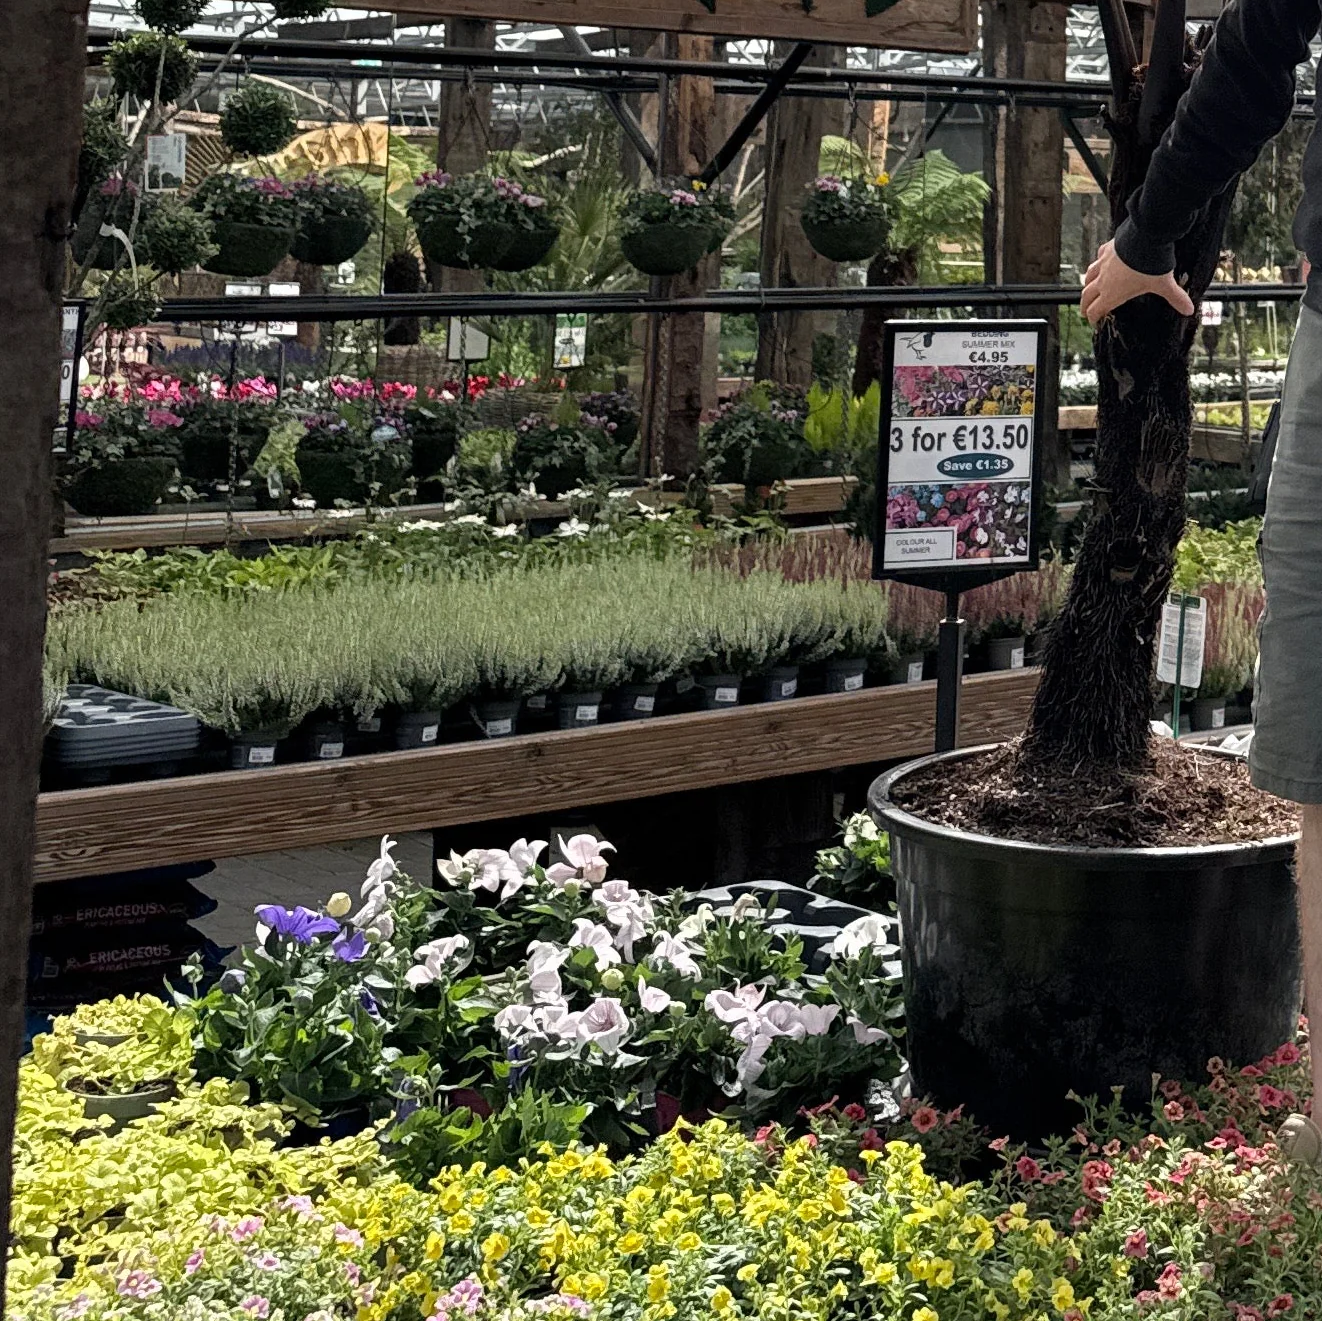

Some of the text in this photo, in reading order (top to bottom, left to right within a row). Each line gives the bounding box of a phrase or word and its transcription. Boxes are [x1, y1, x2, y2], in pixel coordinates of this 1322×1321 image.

[961, 339, 1016, 350] SUMMER MIX
[968, 351, 1009, 364] €4.95
[890, 423, 1029, 453] 3 for €13.50
[943, 458, 1009, 472] Save €1.35
[896, 537, 938, 546] COLOUR ALL
[901, 546, 931, 555] SUMMER
[76, 902, 158, 922] ERICACEOUS
[89, 944, 172, 964] ERICACEOUS
